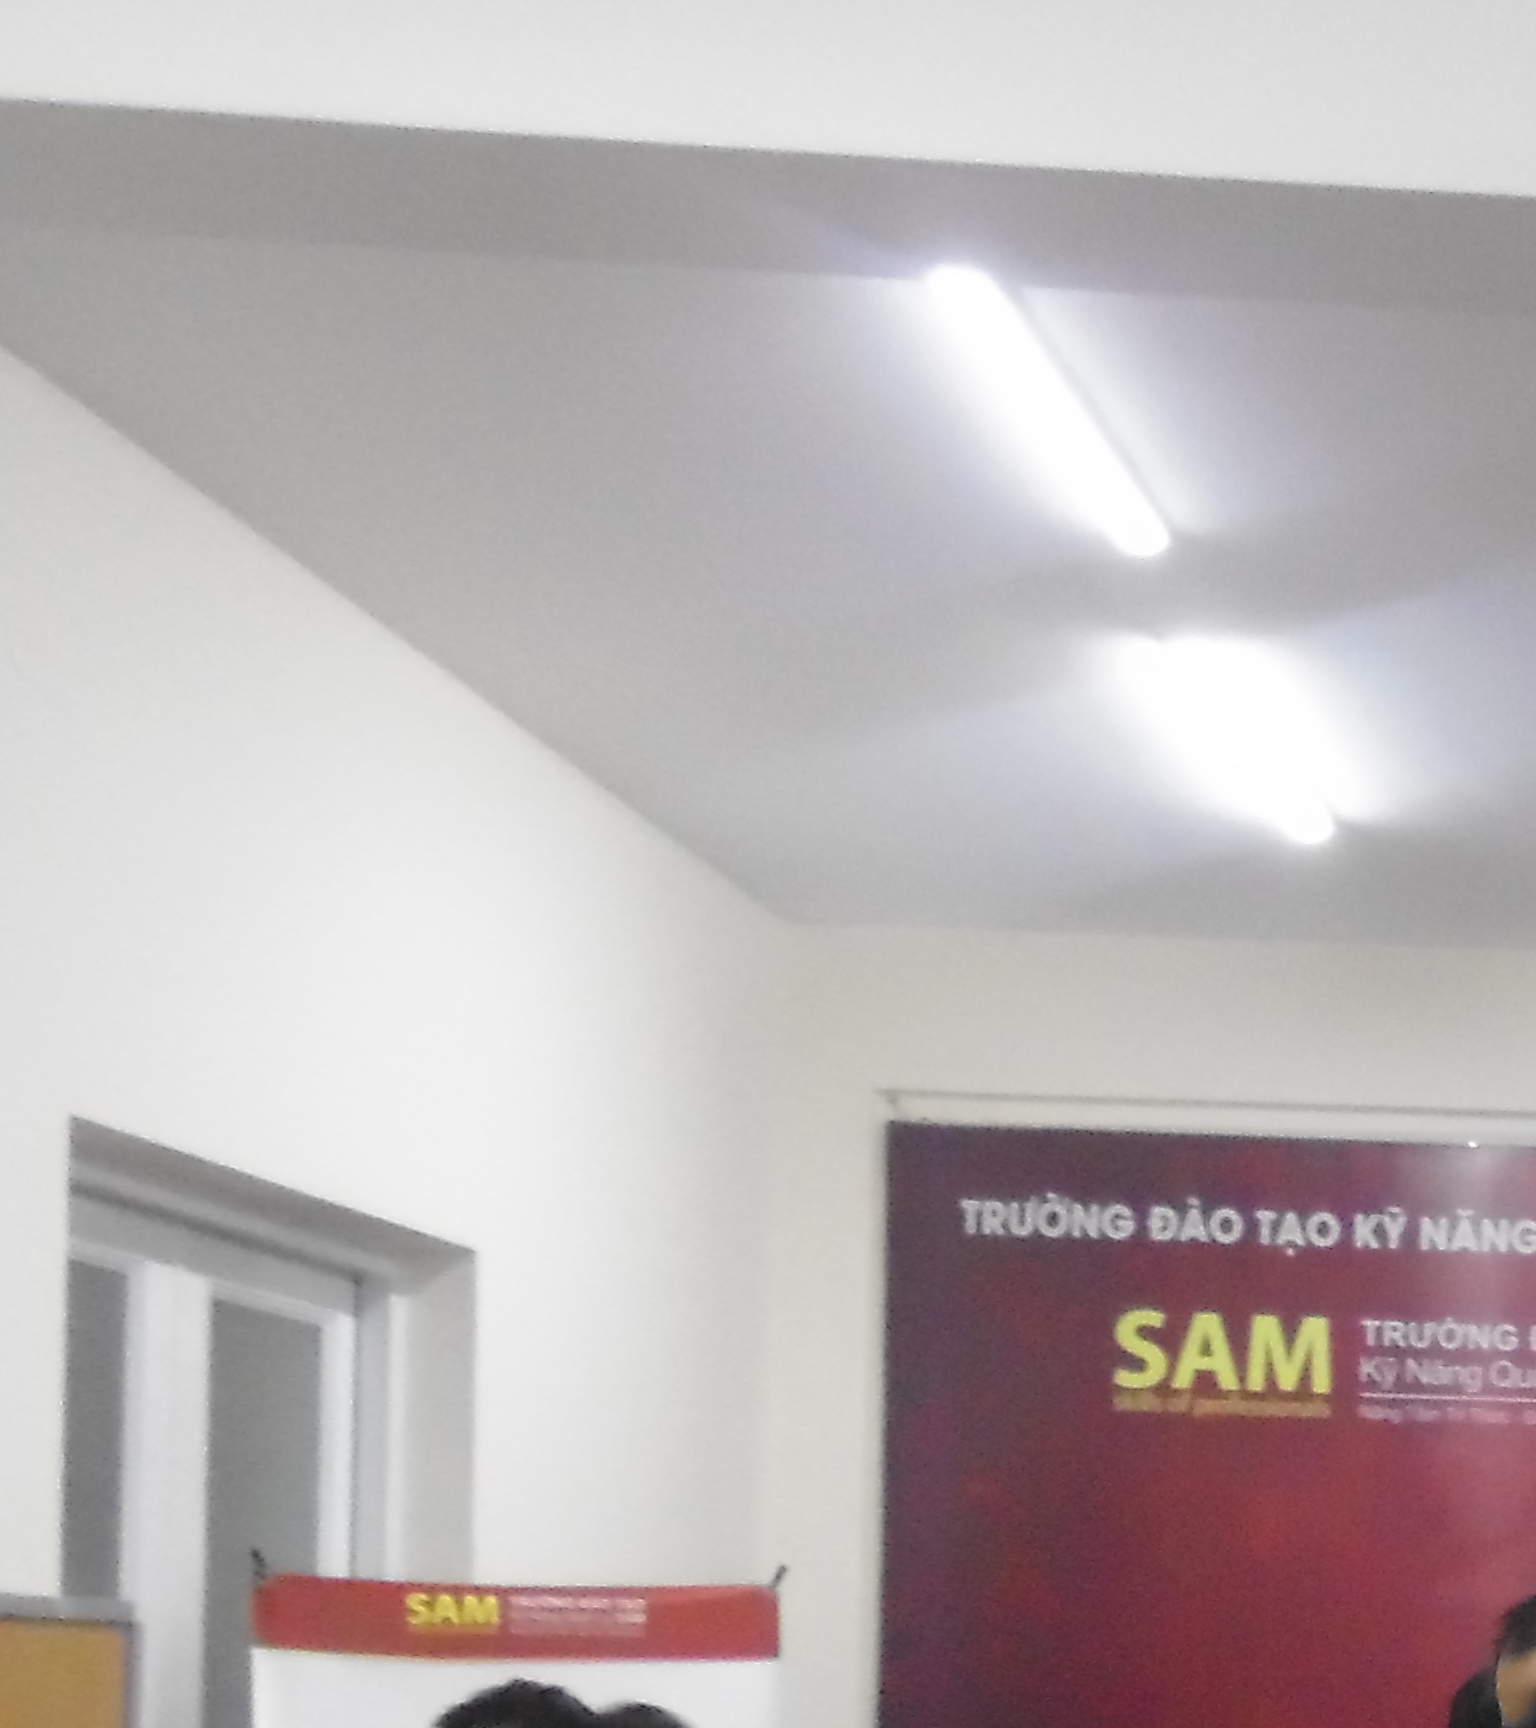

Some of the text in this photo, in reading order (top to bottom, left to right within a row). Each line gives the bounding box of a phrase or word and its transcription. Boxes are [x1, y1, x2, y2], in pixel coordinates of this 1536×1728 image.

[960, 1193, 1136, 1241] TRƯỜNG
[1147, 1197, 1244, 1245] ĐÀO
[1255, 1209, 1341, 1257] TẠO
[1352, 1205, 1406, 1250] KỸ
[1113, 1308, 1332, 1396] SAM
[406, 1592, 500, 1625] SAM
